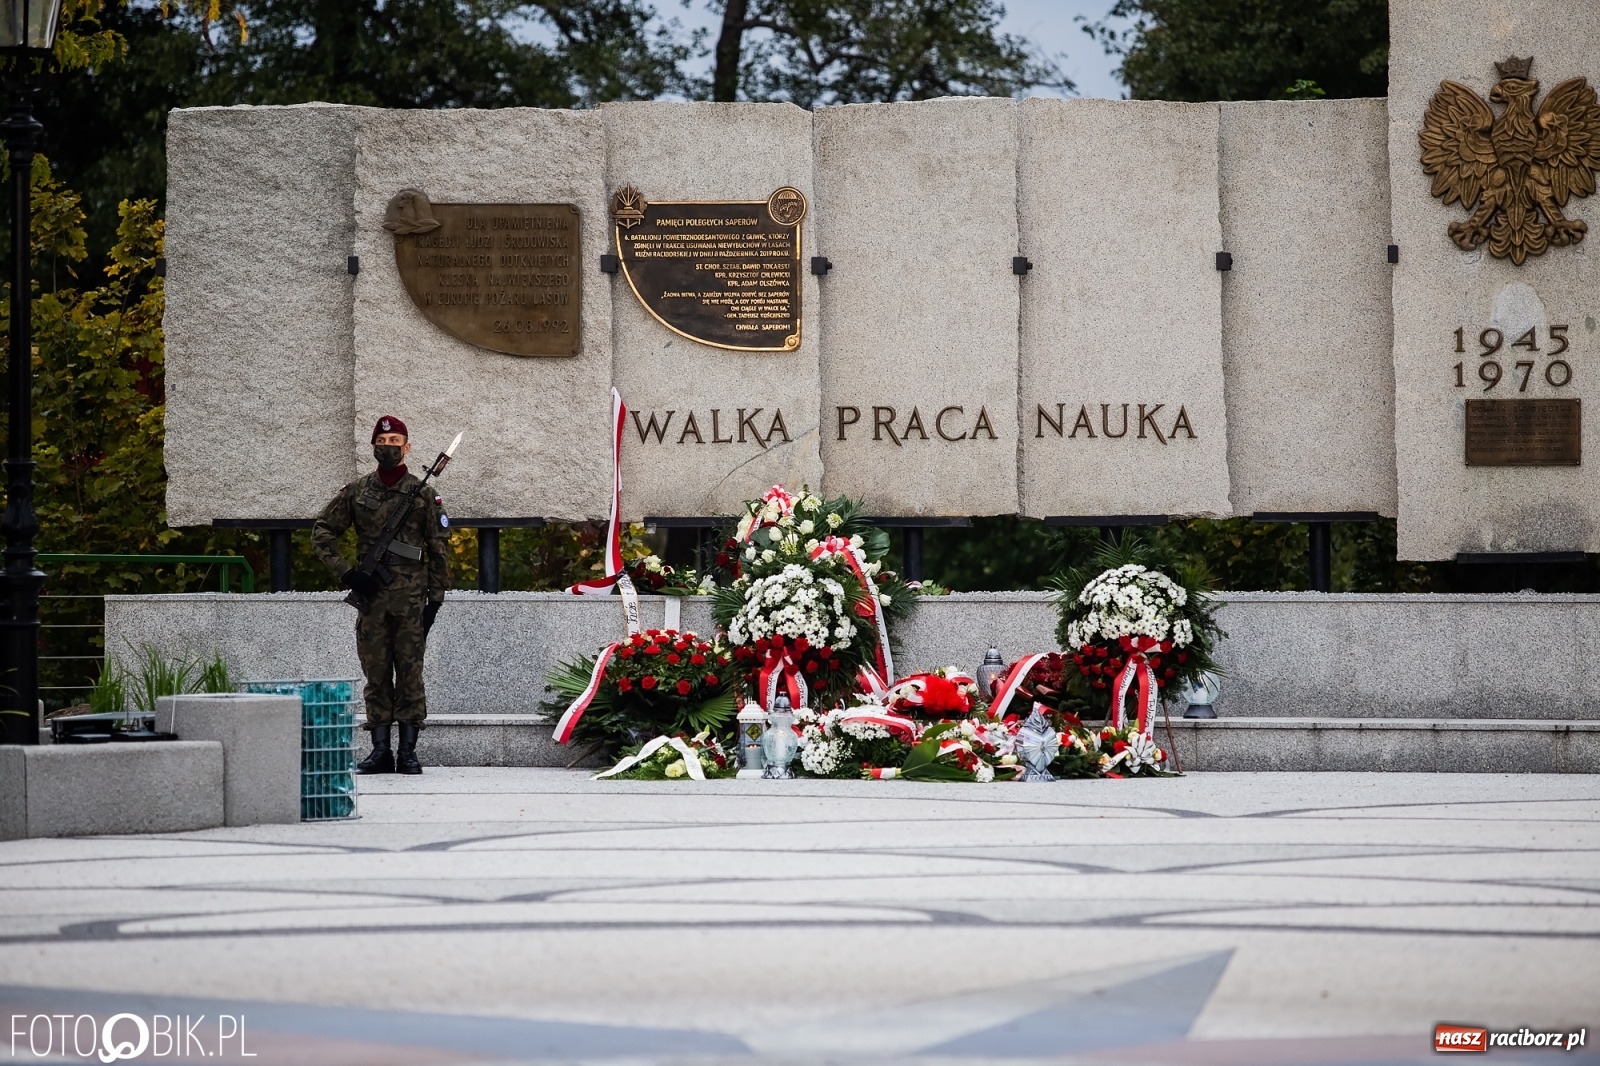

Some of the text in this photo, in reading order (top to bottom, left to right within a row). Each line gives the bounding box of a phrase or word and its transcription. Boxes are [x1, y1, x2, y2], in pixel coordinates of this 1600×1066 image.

[467, 217, 486, 230] DLA
[656, 219, 684, 227] PAMIĘCI
[725, 217, 758, 225] SAPERÓW
[1454, 325, 1569, 357] 1945
[1454, 360, 1572, 392] 1970
[630, 403, 1198, 448] WALKA PRACA NAUKA
